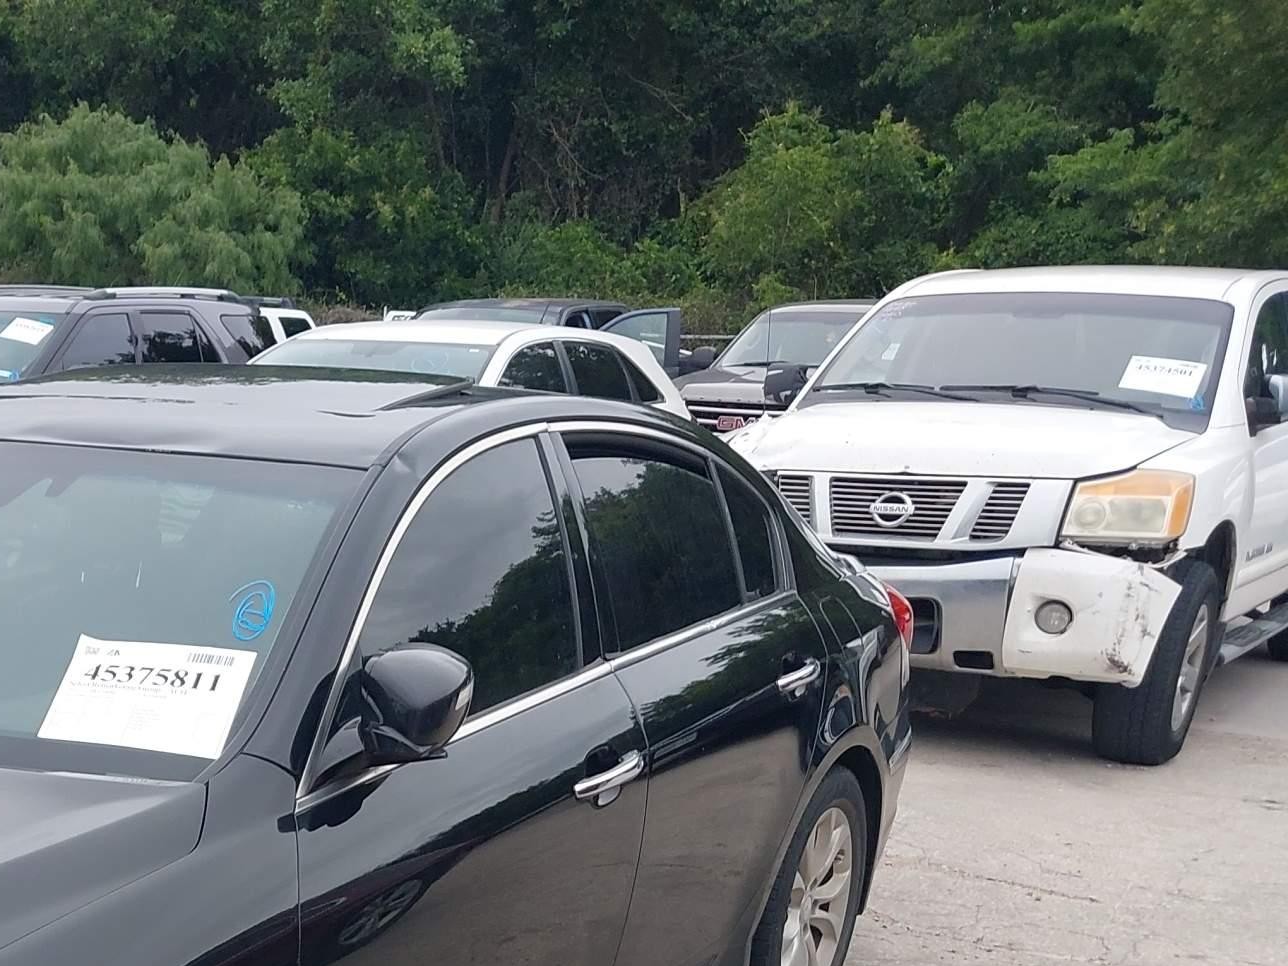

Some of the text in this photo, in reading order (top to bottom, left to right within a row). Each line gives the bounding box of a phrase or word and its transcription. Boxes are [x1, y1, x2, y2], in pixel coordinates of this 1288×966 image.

[717, 416, 759, 430] GM
[873, 505, 909, 513] NISSAN
[84, 663, 221, 692] 45375811
